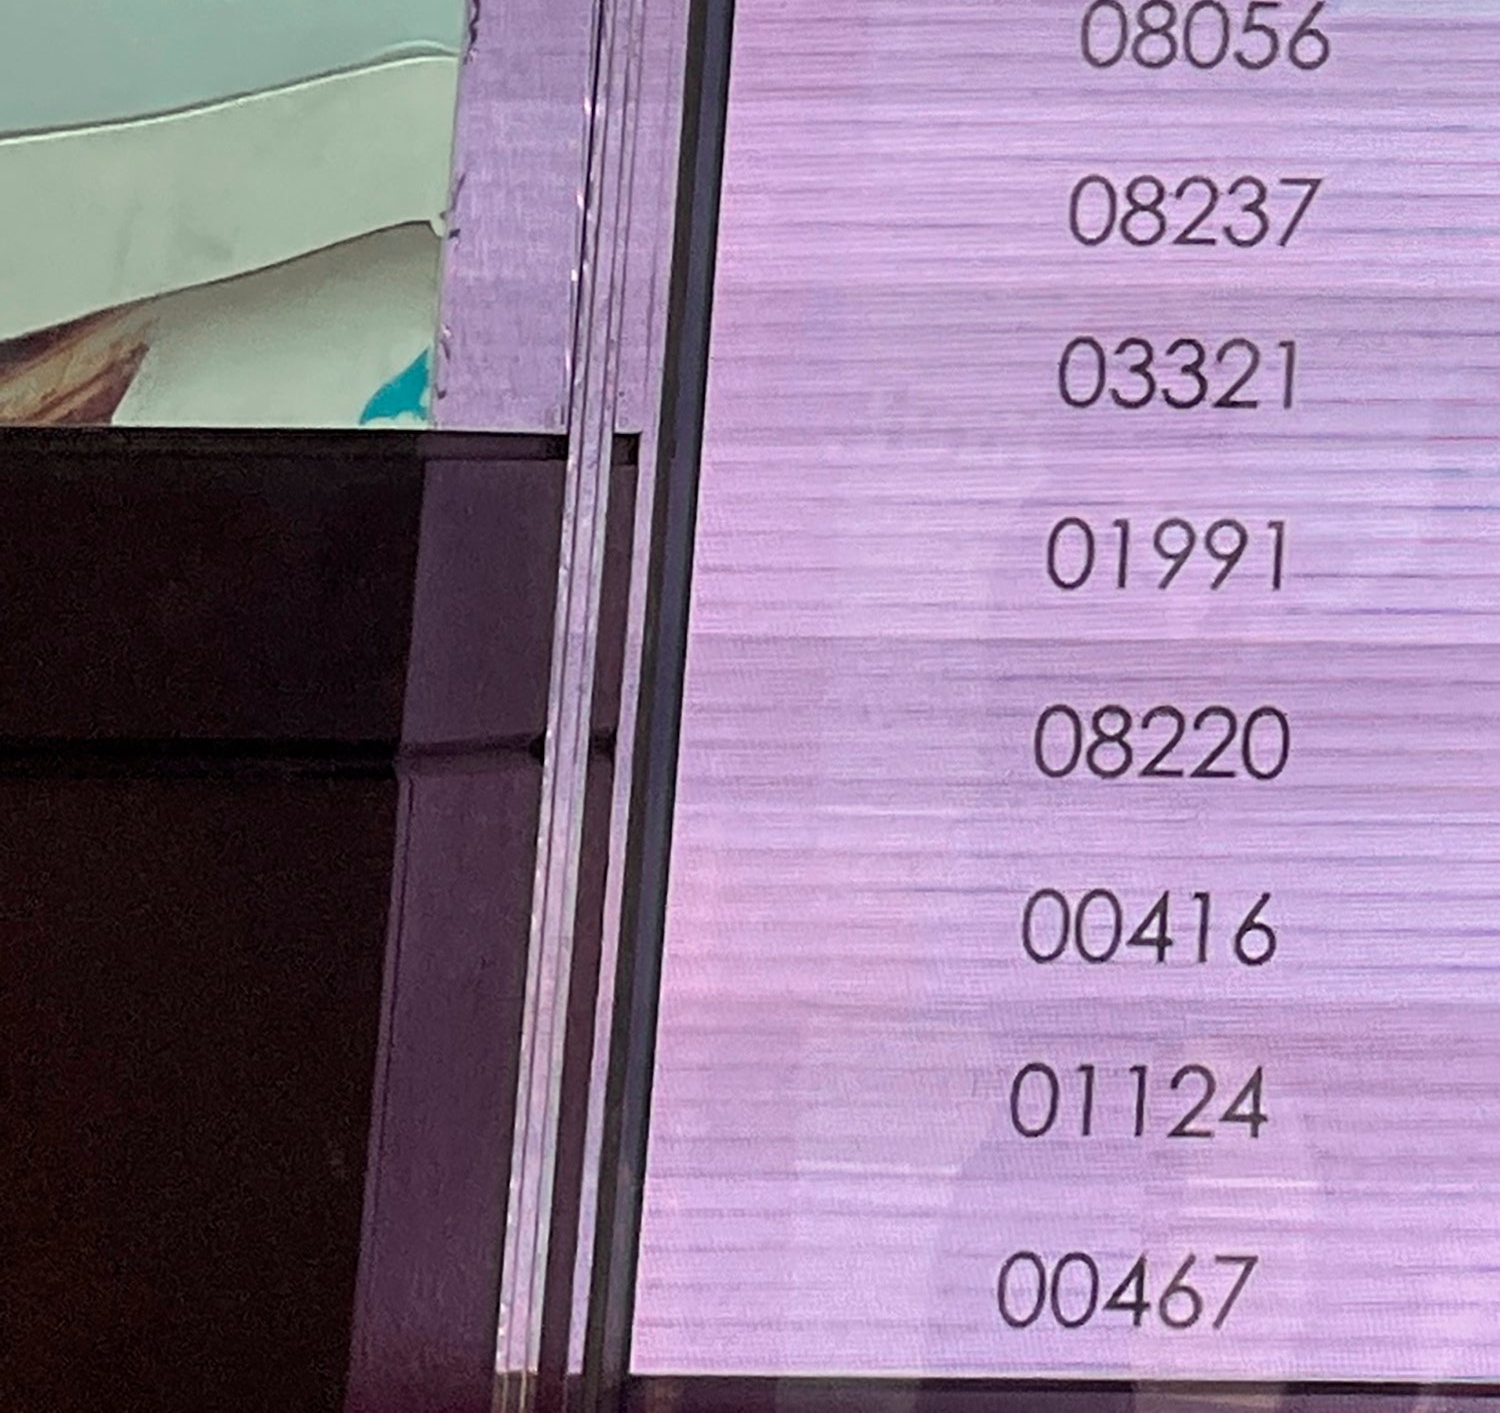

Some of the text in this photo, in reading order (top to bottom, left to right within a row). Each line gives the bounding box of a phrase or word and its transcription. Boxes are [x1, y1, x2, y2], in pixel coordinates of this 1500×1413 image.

[1069, 175, 1322, 248] 08237
[1058, 336, 1295, 410] 03321
[1047, 517, 1284, 591] 01991
[1034, 704, 1290, 781] 08220
[1022, 888, 1277, 967] 00416
[1010, 1062, 1268, 1138] 01124
[997, 1250, 1258, 1329] 00467
